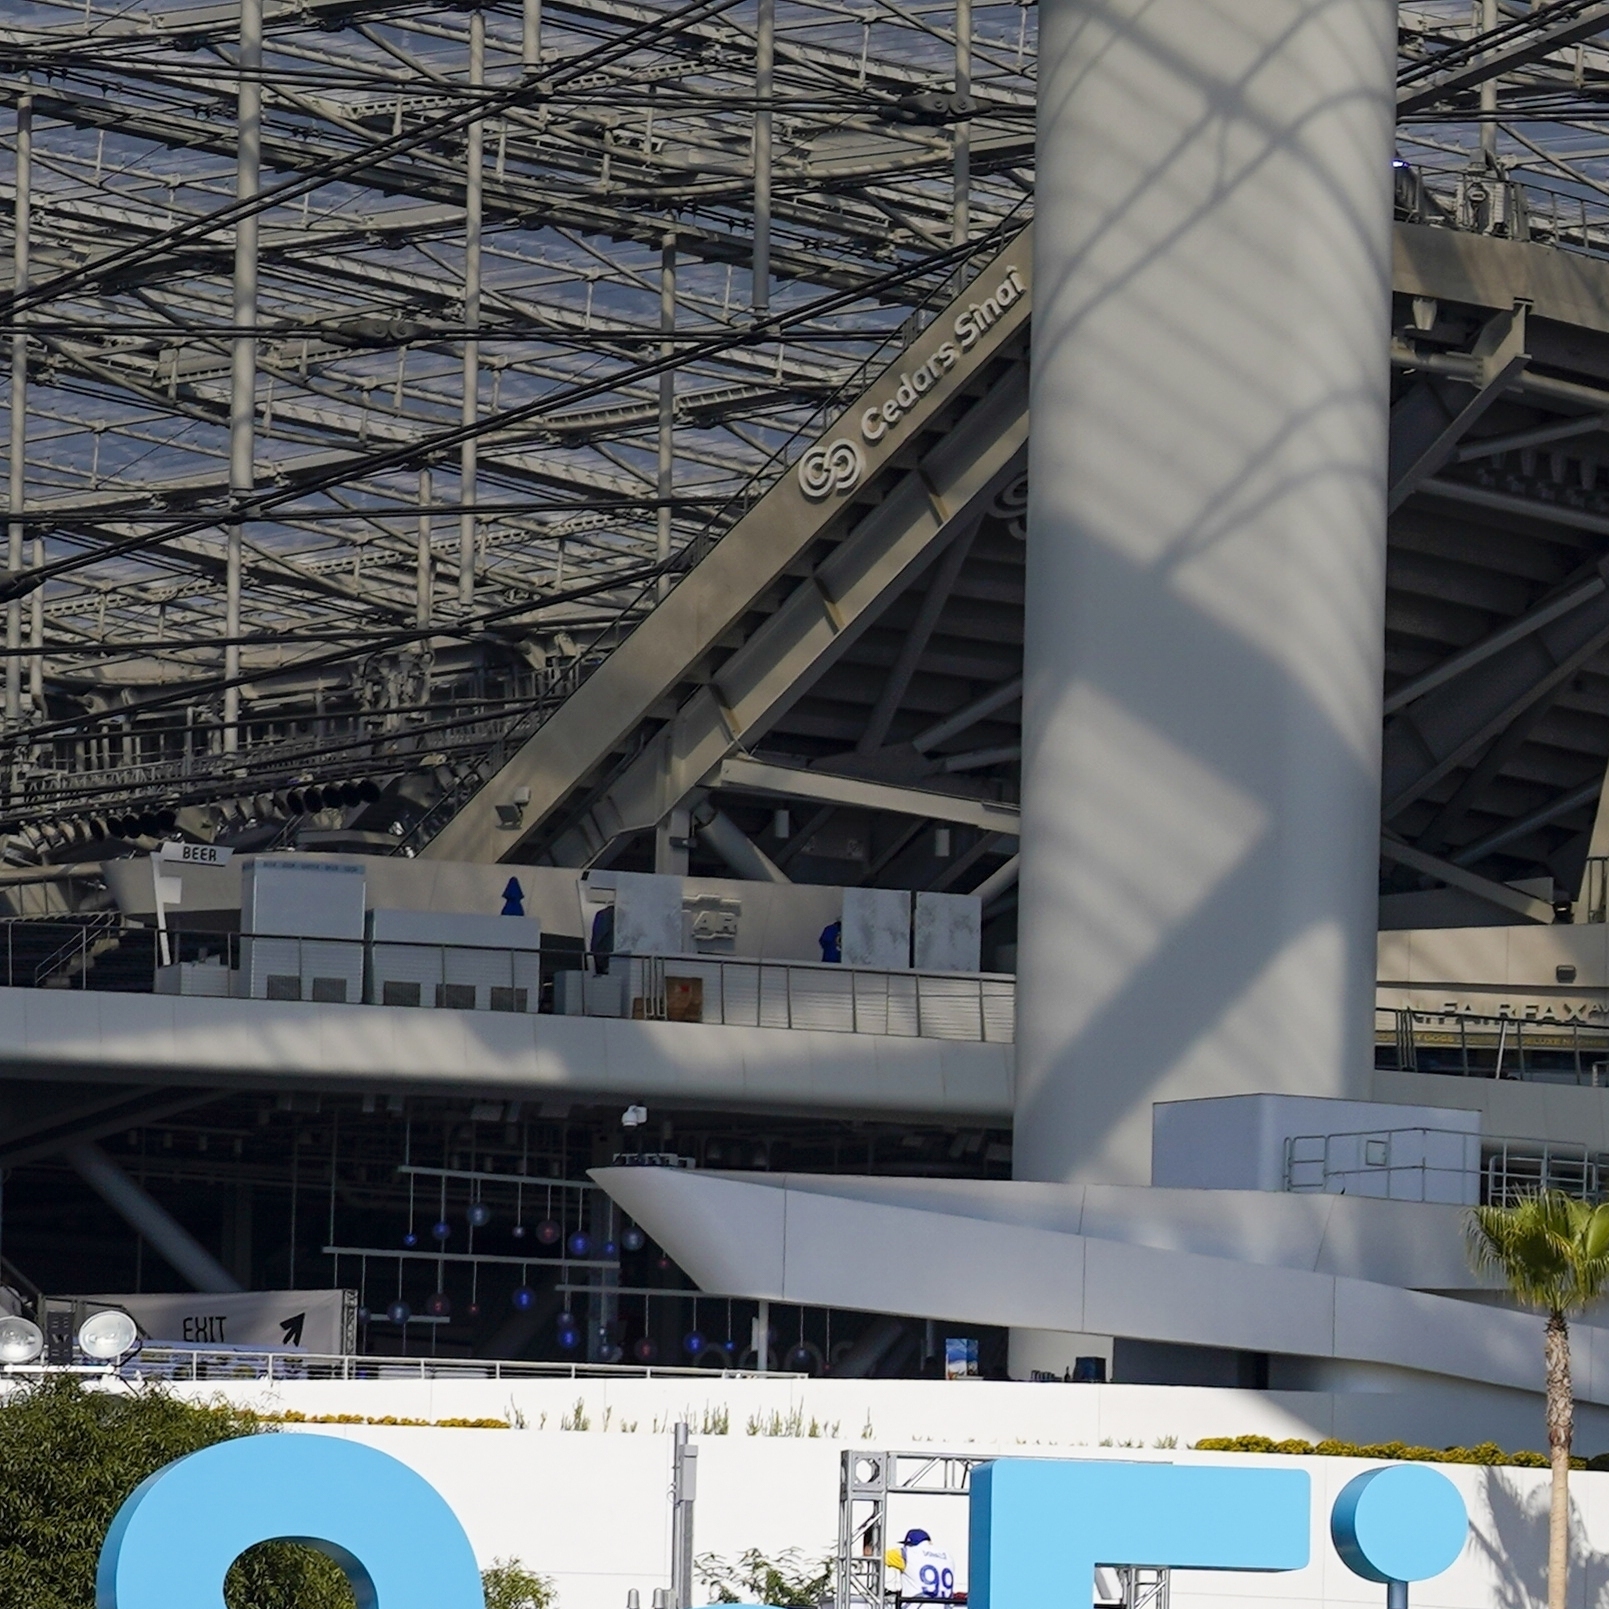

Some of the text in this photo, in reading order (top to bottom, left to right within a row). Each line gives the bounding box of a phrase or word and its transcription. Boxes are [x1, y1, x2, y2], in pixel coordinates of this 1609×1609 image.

[861, 264, 1027, 440] Cedars Sinai
[182, 846, 217, 862] BEER
[182, 1315, 228, 1343] EXIT
[918, 1564, 955, 1599] 99
